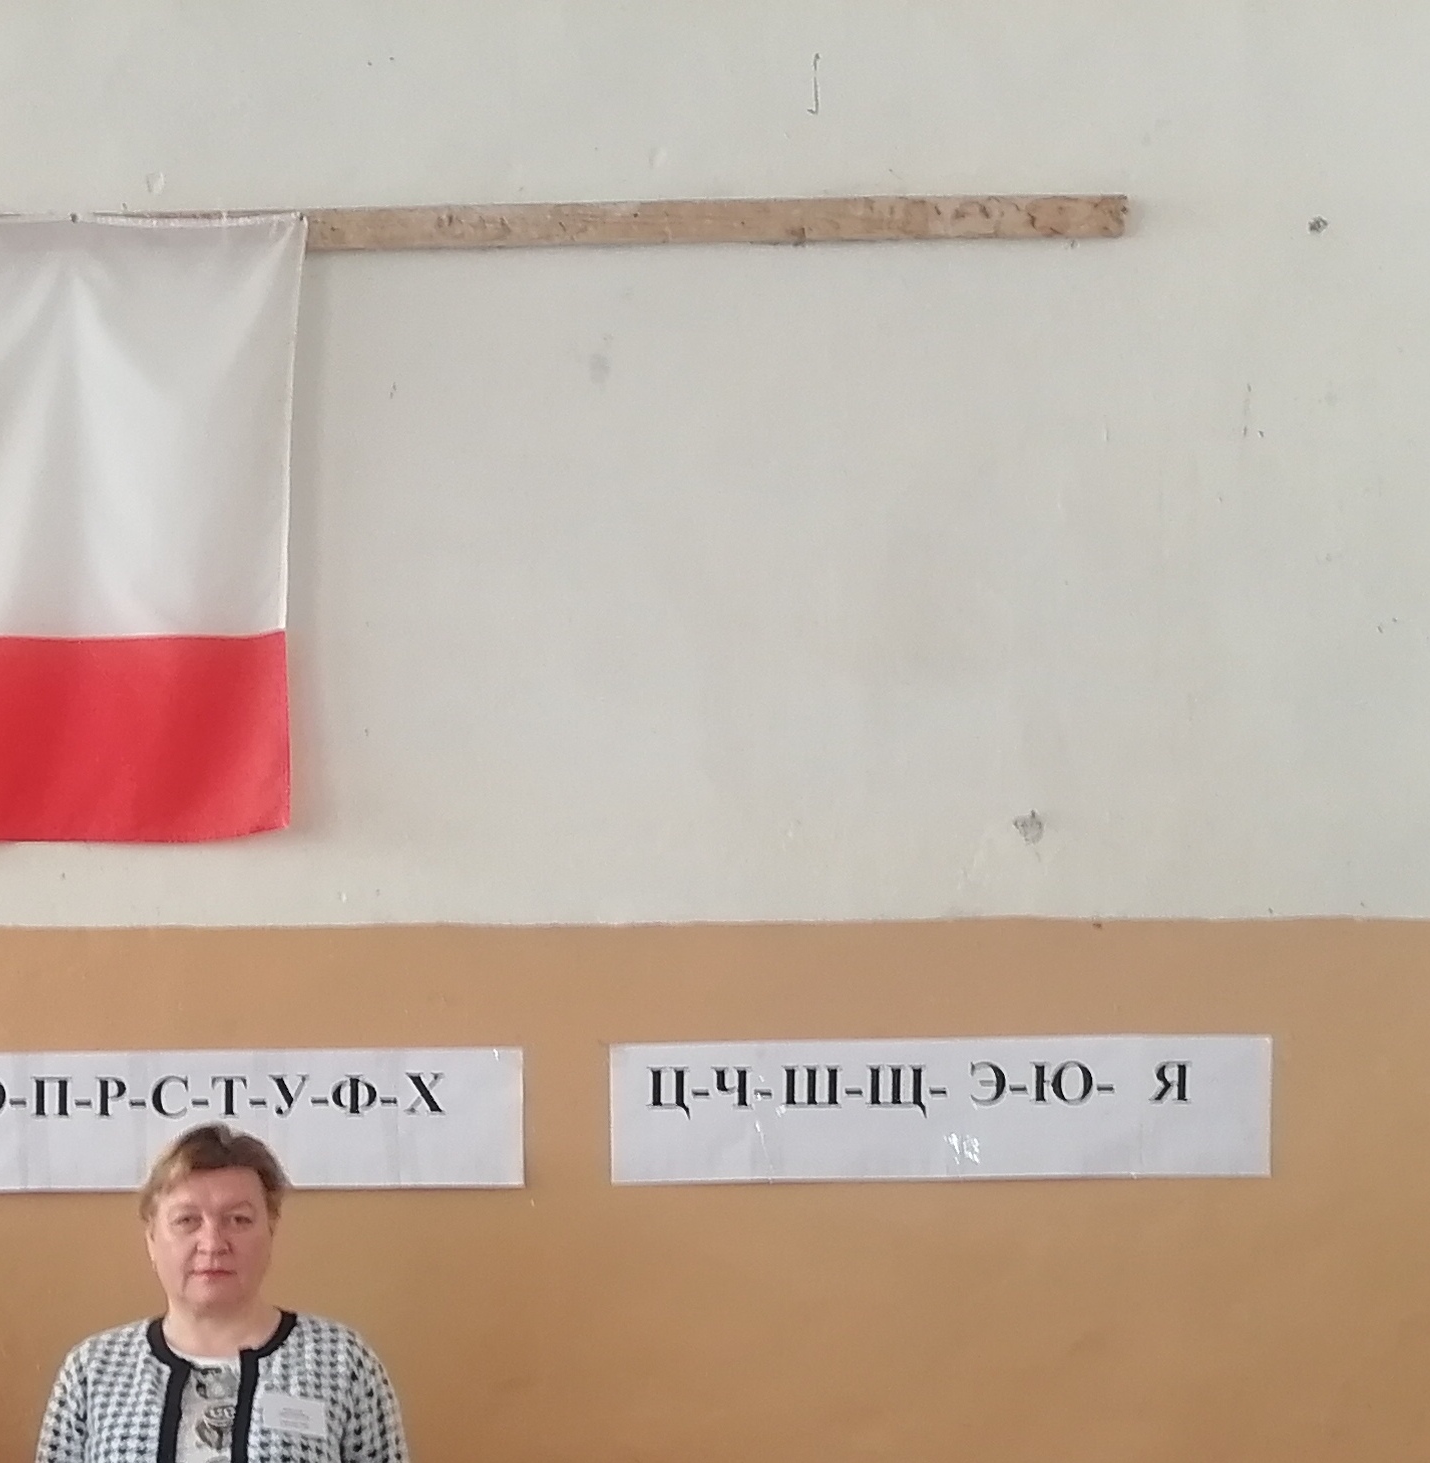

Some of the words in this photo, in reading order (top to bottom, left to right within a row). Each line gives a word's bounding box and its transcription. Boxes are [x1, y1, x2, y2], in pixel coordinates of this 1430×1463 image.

[647, 1064, 948, 1119] Ц-Ч-Ш-Щ-
[970, 1060, 1116, 1105] Э-Ю-
[1149, 1060, 1190, 1103] Я
